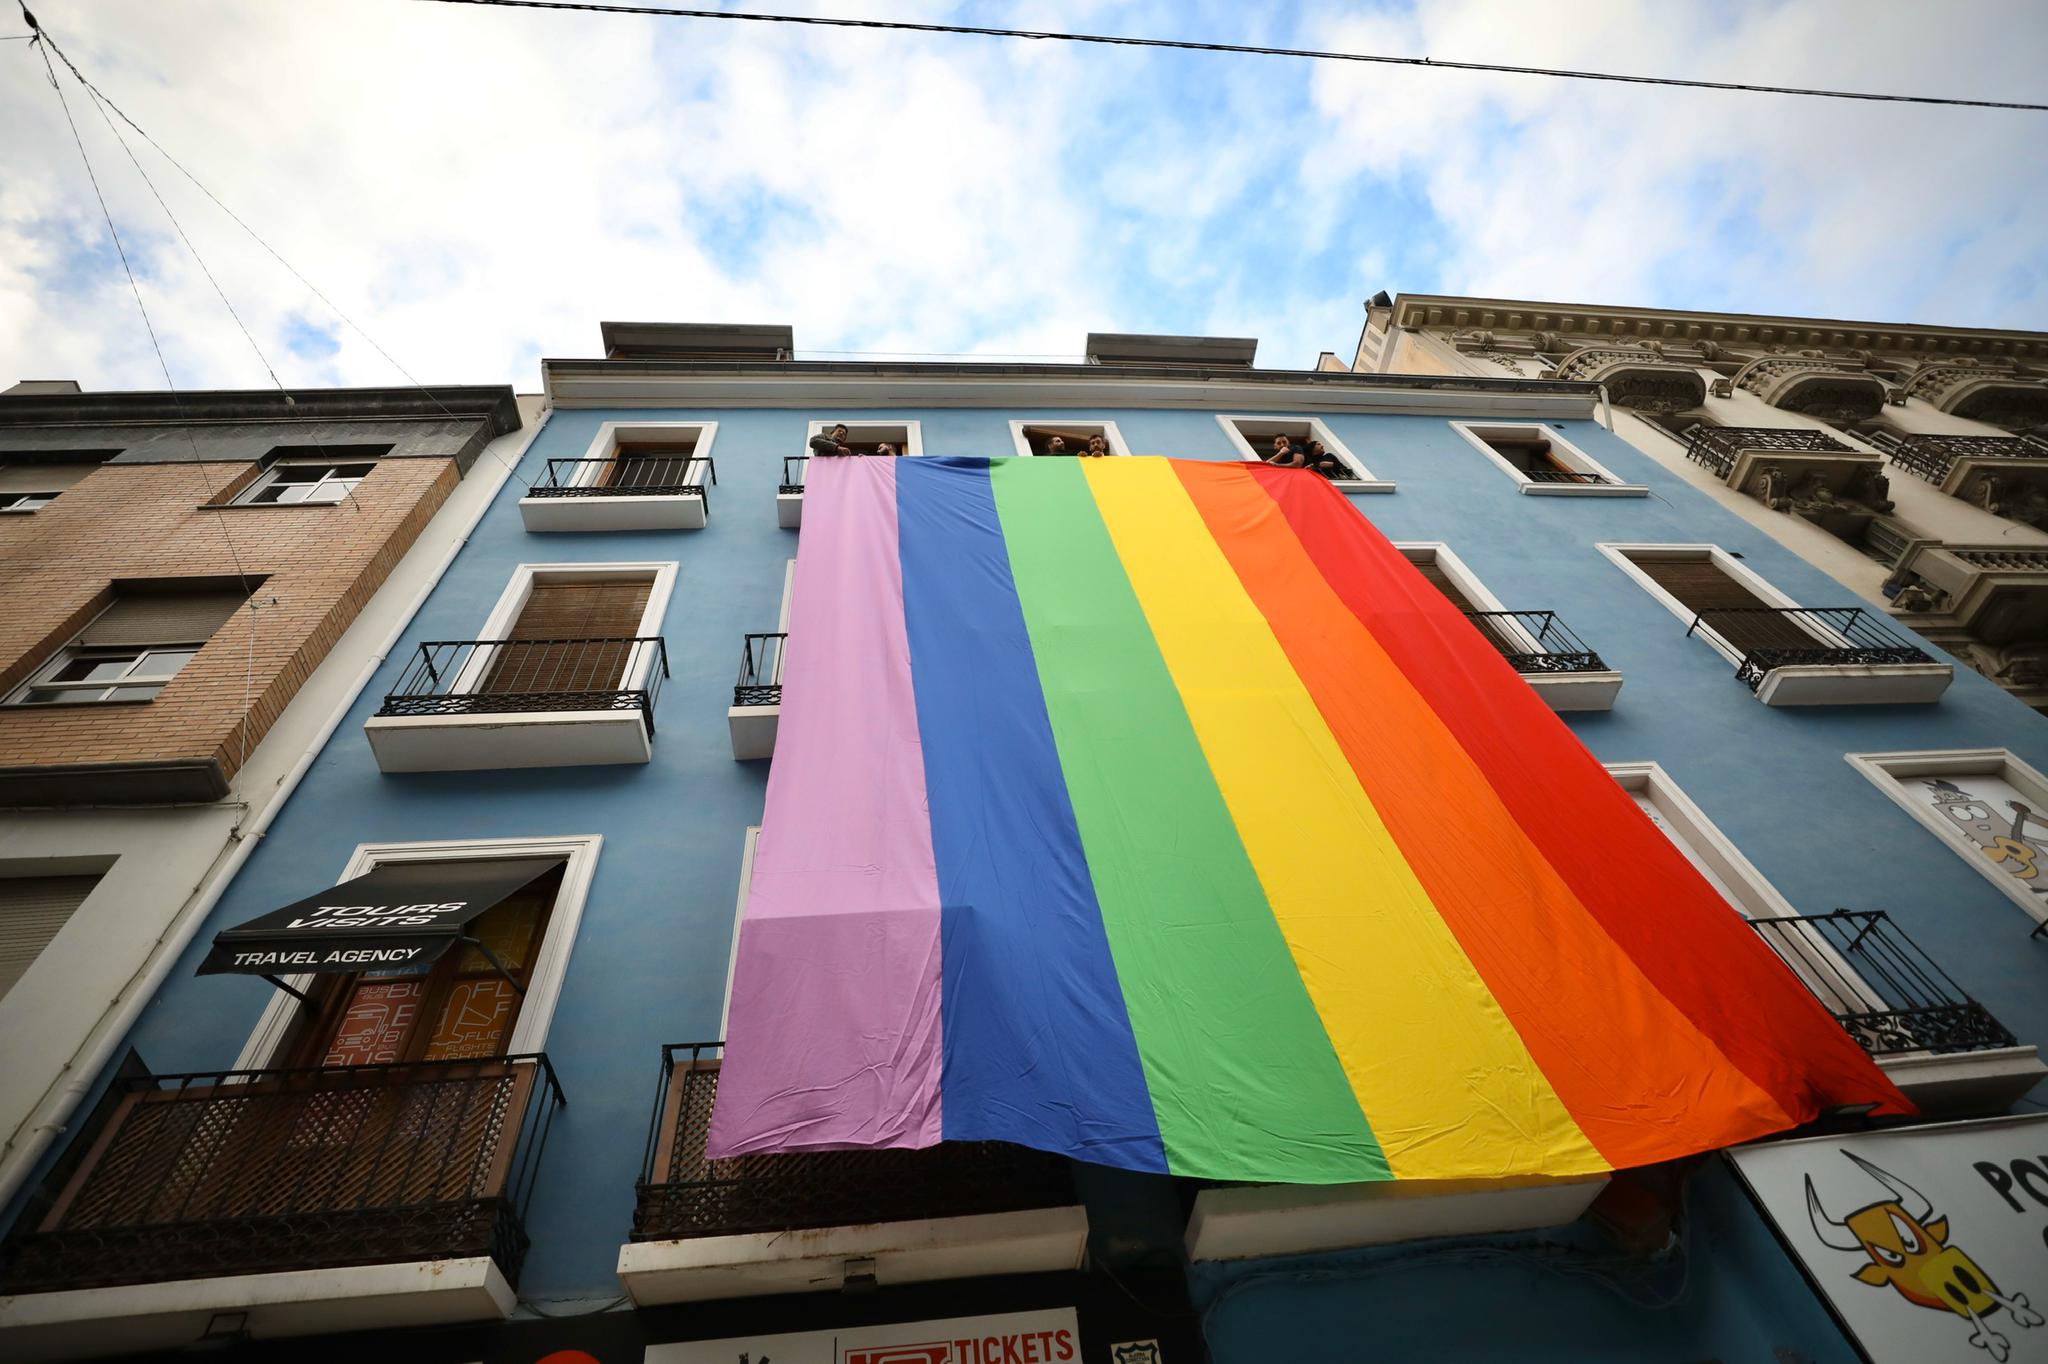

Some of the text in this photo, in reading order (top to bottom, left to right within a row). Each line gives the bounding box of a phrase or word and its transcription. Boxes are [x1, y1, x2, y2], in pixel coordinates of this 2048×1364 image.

[309, 902, 467, 918] TOURS
[287, 914, 437, 929] VISITS
[234, 947, 423, 966] TRAVEL AGENCY
[1973, 1156, 2048, 1213] PO
[955, 1330, 1073, 1364] TICKETS
